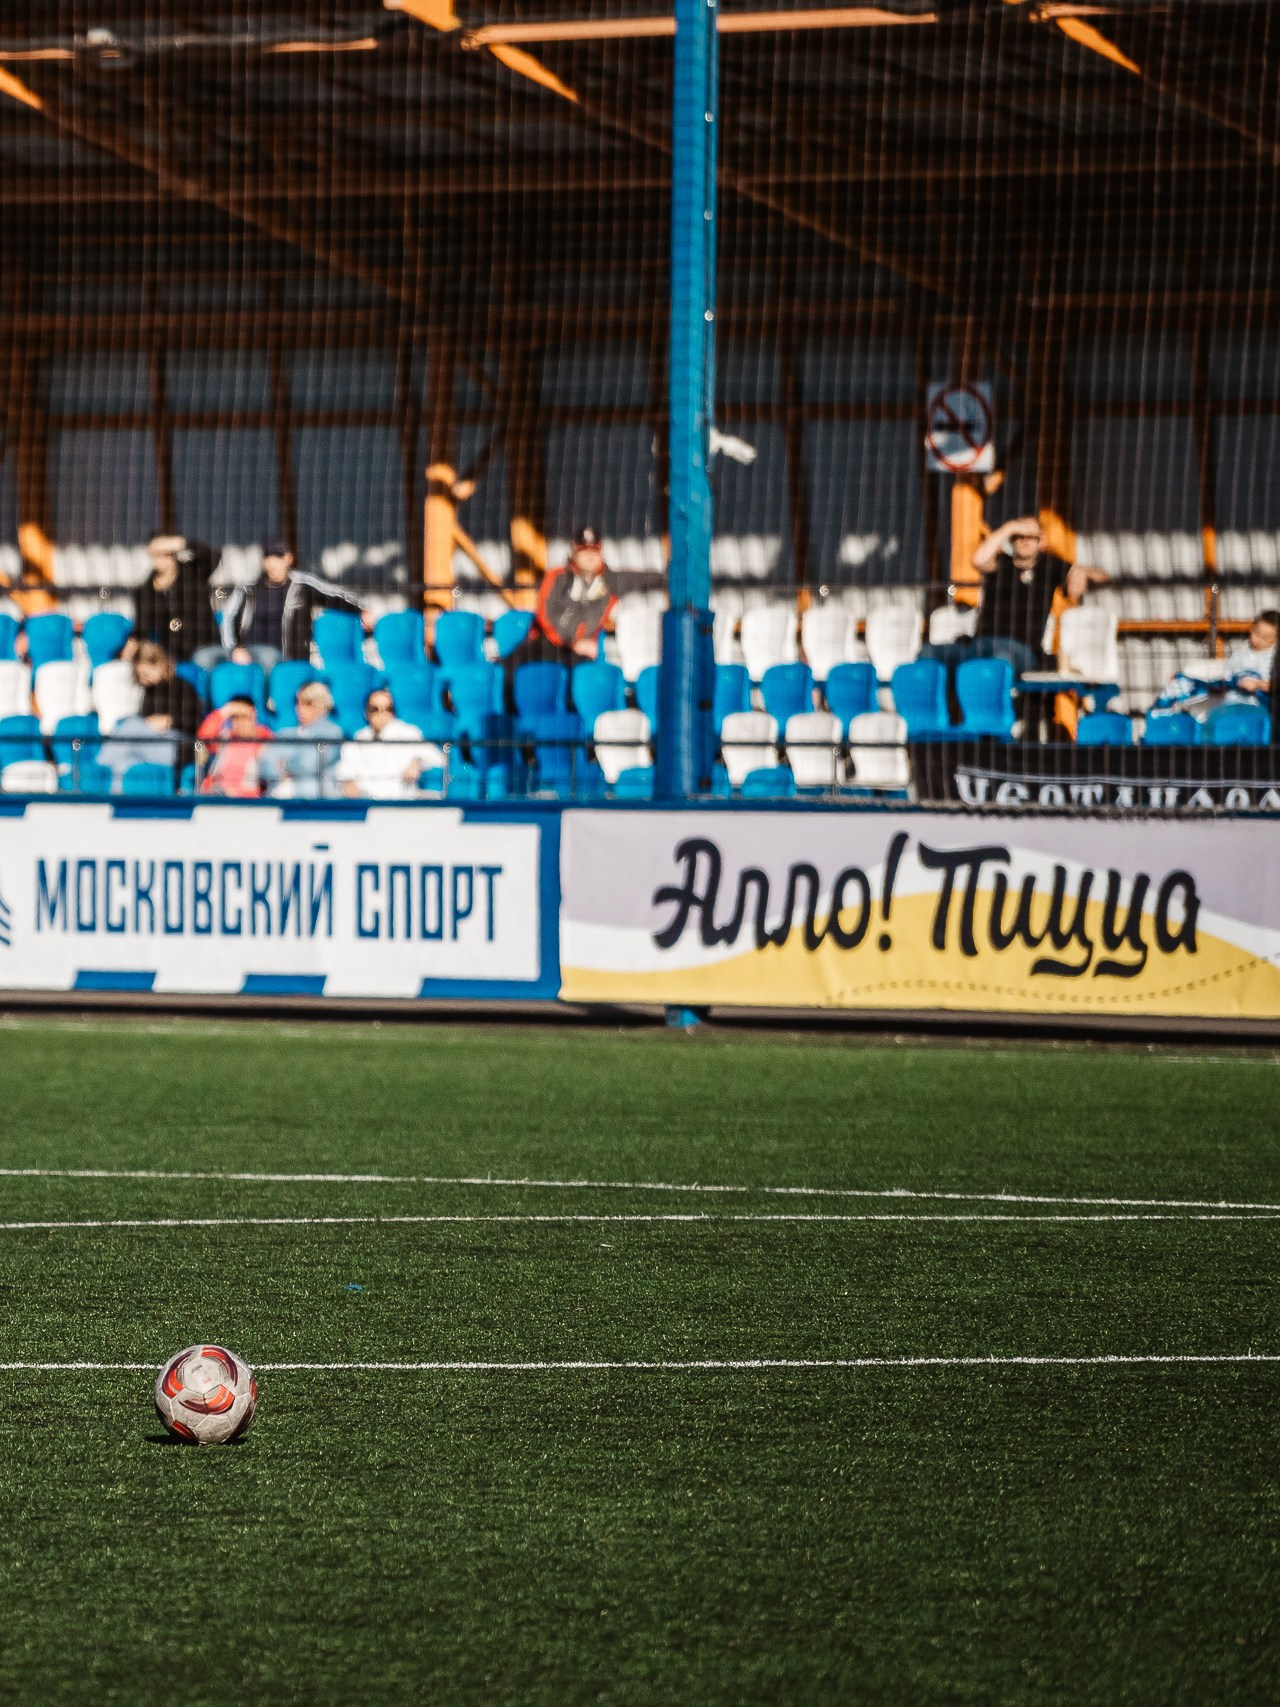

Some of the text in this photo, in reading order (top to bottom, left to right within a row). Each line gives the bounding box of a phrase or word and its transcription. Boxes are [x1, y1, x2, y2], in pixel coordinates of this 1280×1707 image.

[35, 843, 503, 941] МОСКОВСКИЙ СПОРТ
[652, 830, 1201, 978] Алло! Пицца
